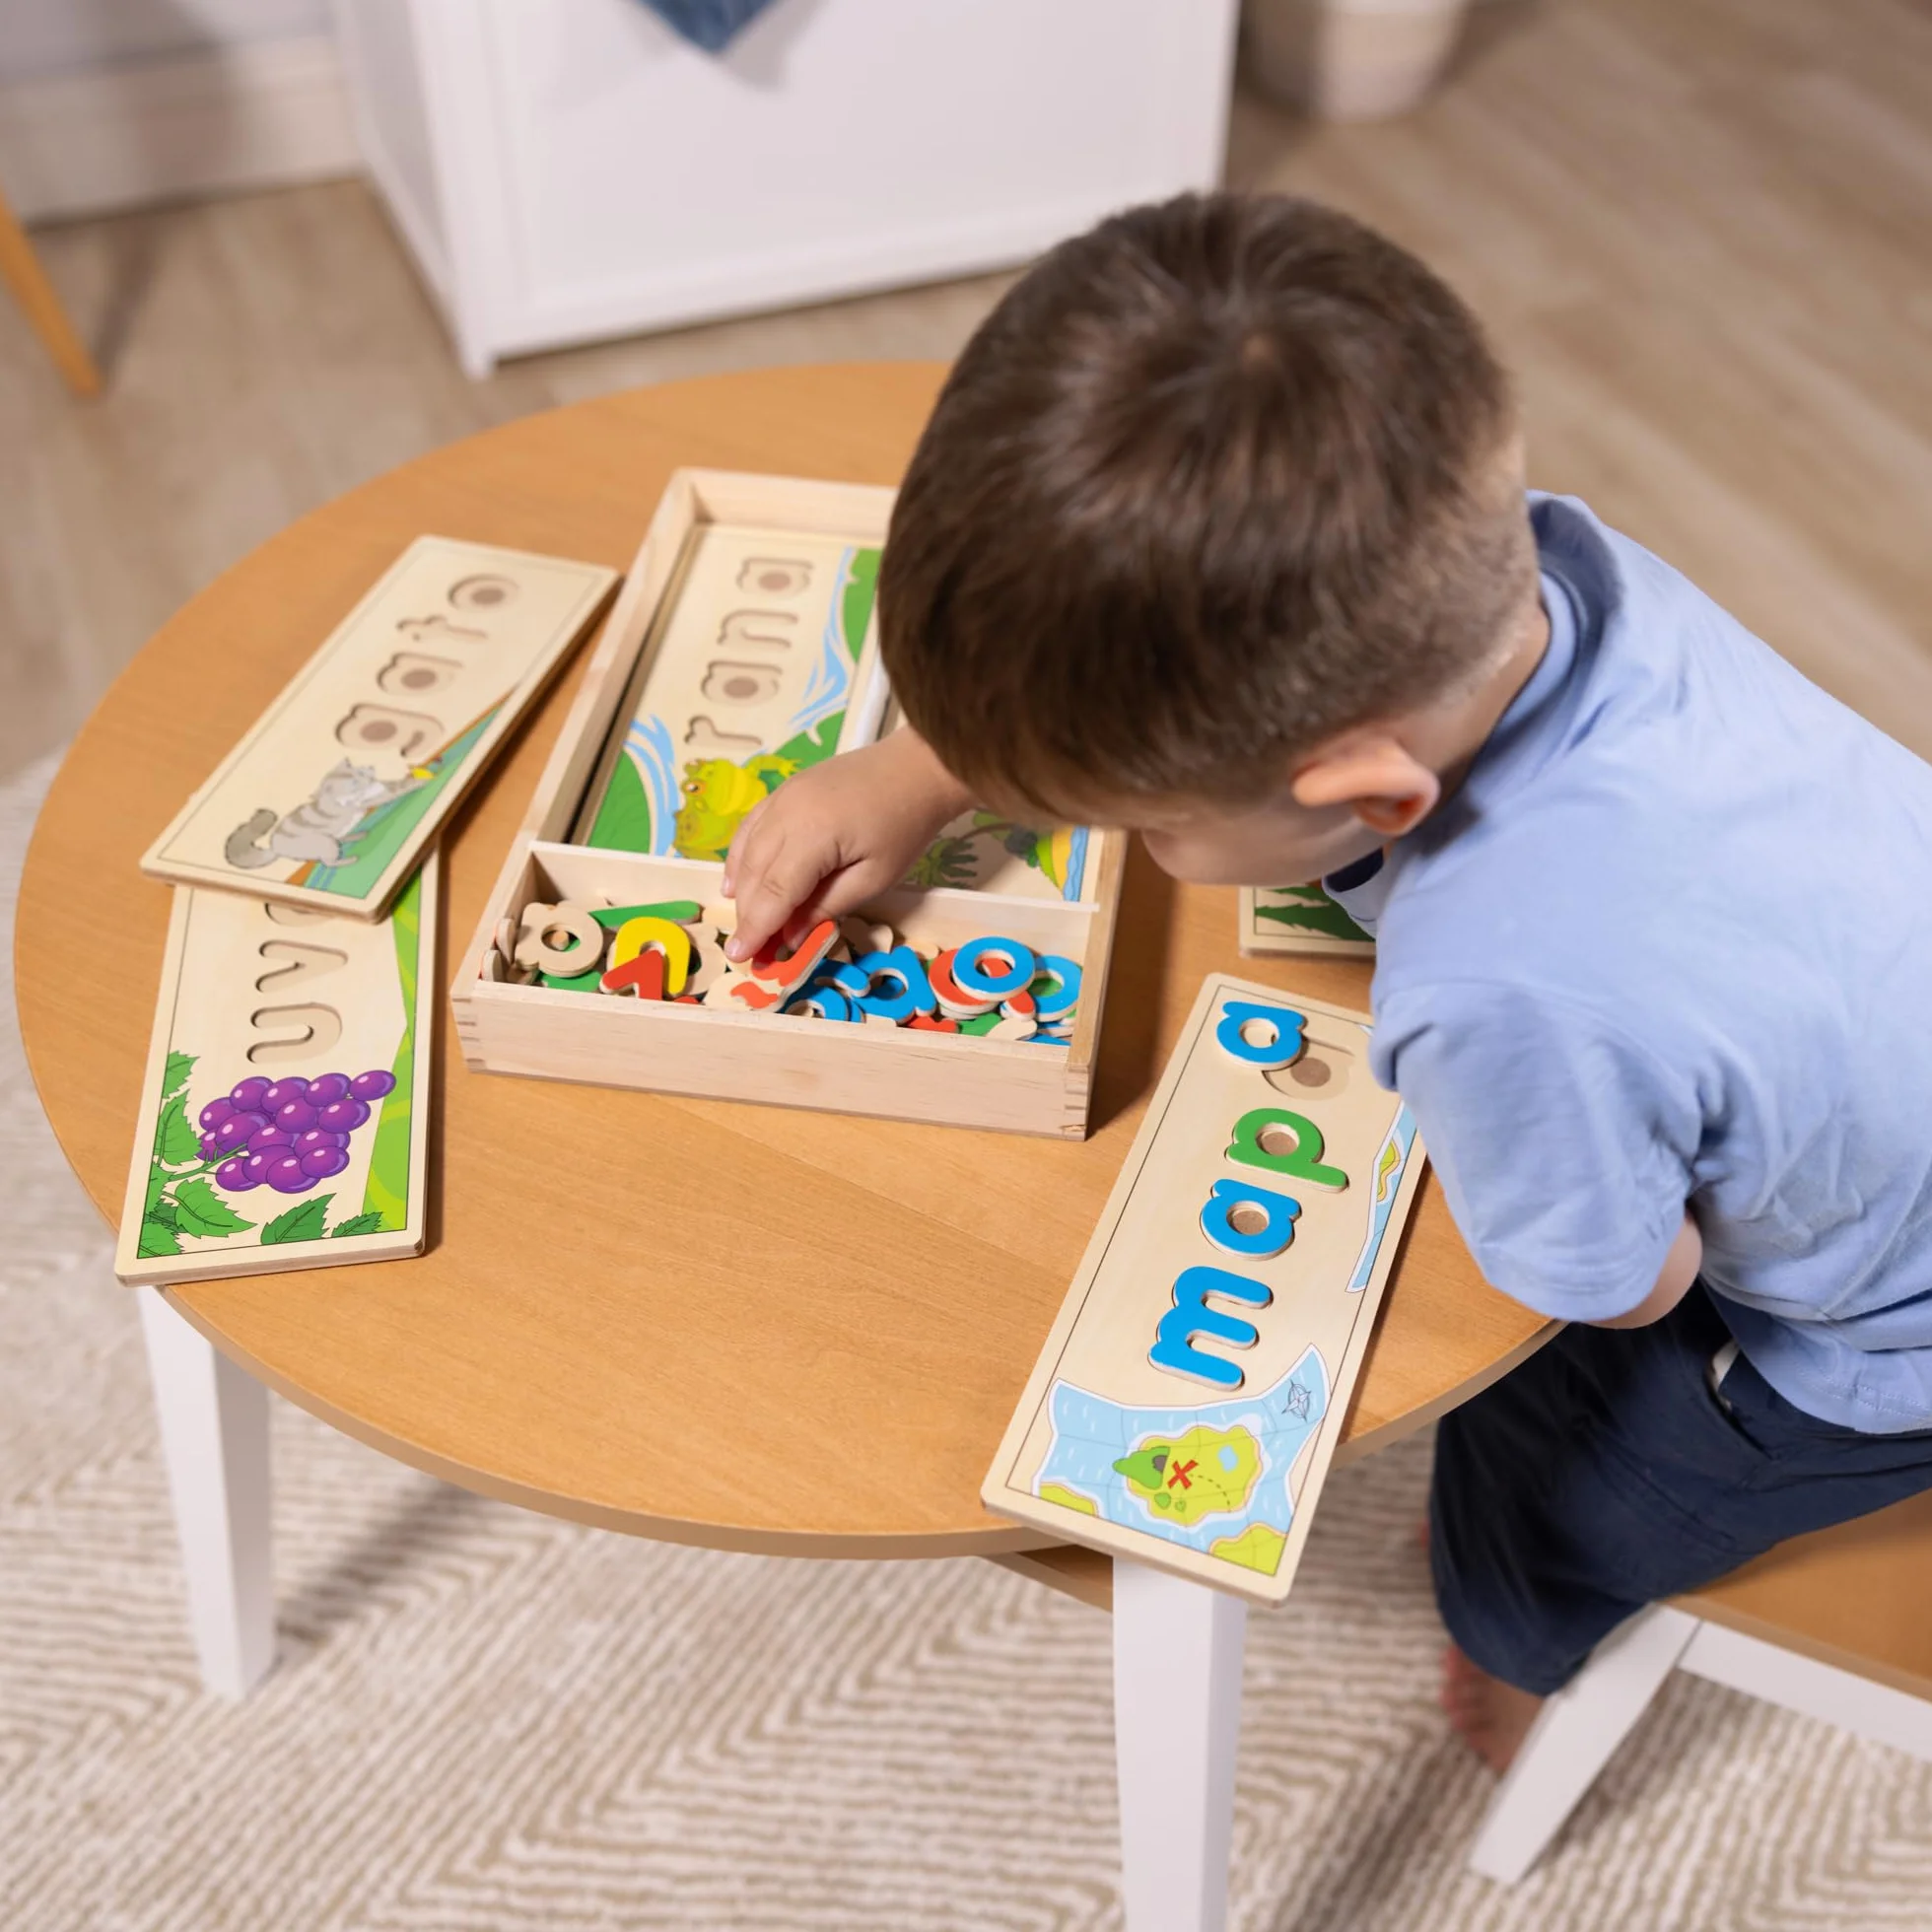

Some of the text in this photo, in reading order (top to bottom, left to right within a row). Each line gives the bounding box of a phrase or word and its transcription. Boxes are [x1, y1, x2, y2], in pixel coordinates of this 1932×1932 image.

[334, 572, 520, 757] gato
[682, 556, 814, 750] rana
[1146, 1000, 1352, 1392] mapa
